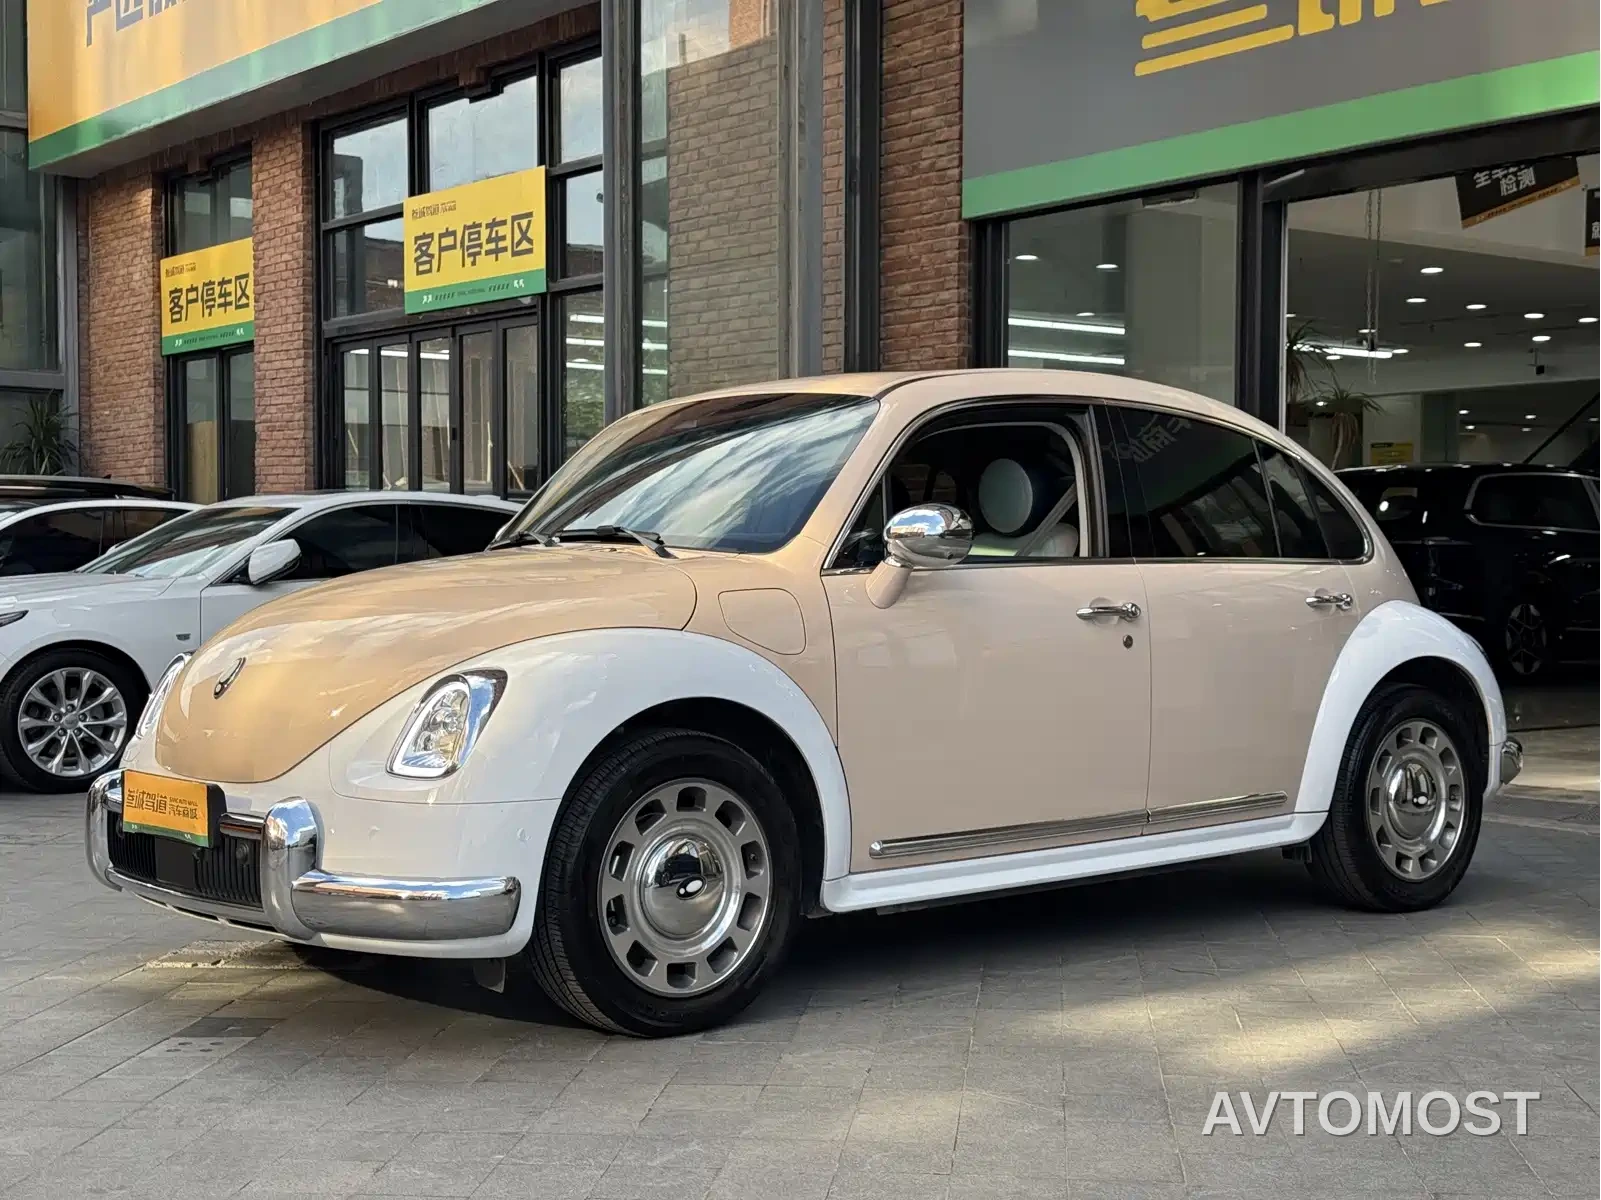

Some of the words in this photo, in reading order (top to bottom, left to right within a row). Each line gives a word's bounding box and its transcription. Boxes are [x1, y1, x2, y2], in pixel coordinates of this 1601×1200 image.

[1500, 167, 1536, 196] 检测
[413, 211, 534, 276] 客户停车区
[169, 272, 250, 324] 客户停车区
